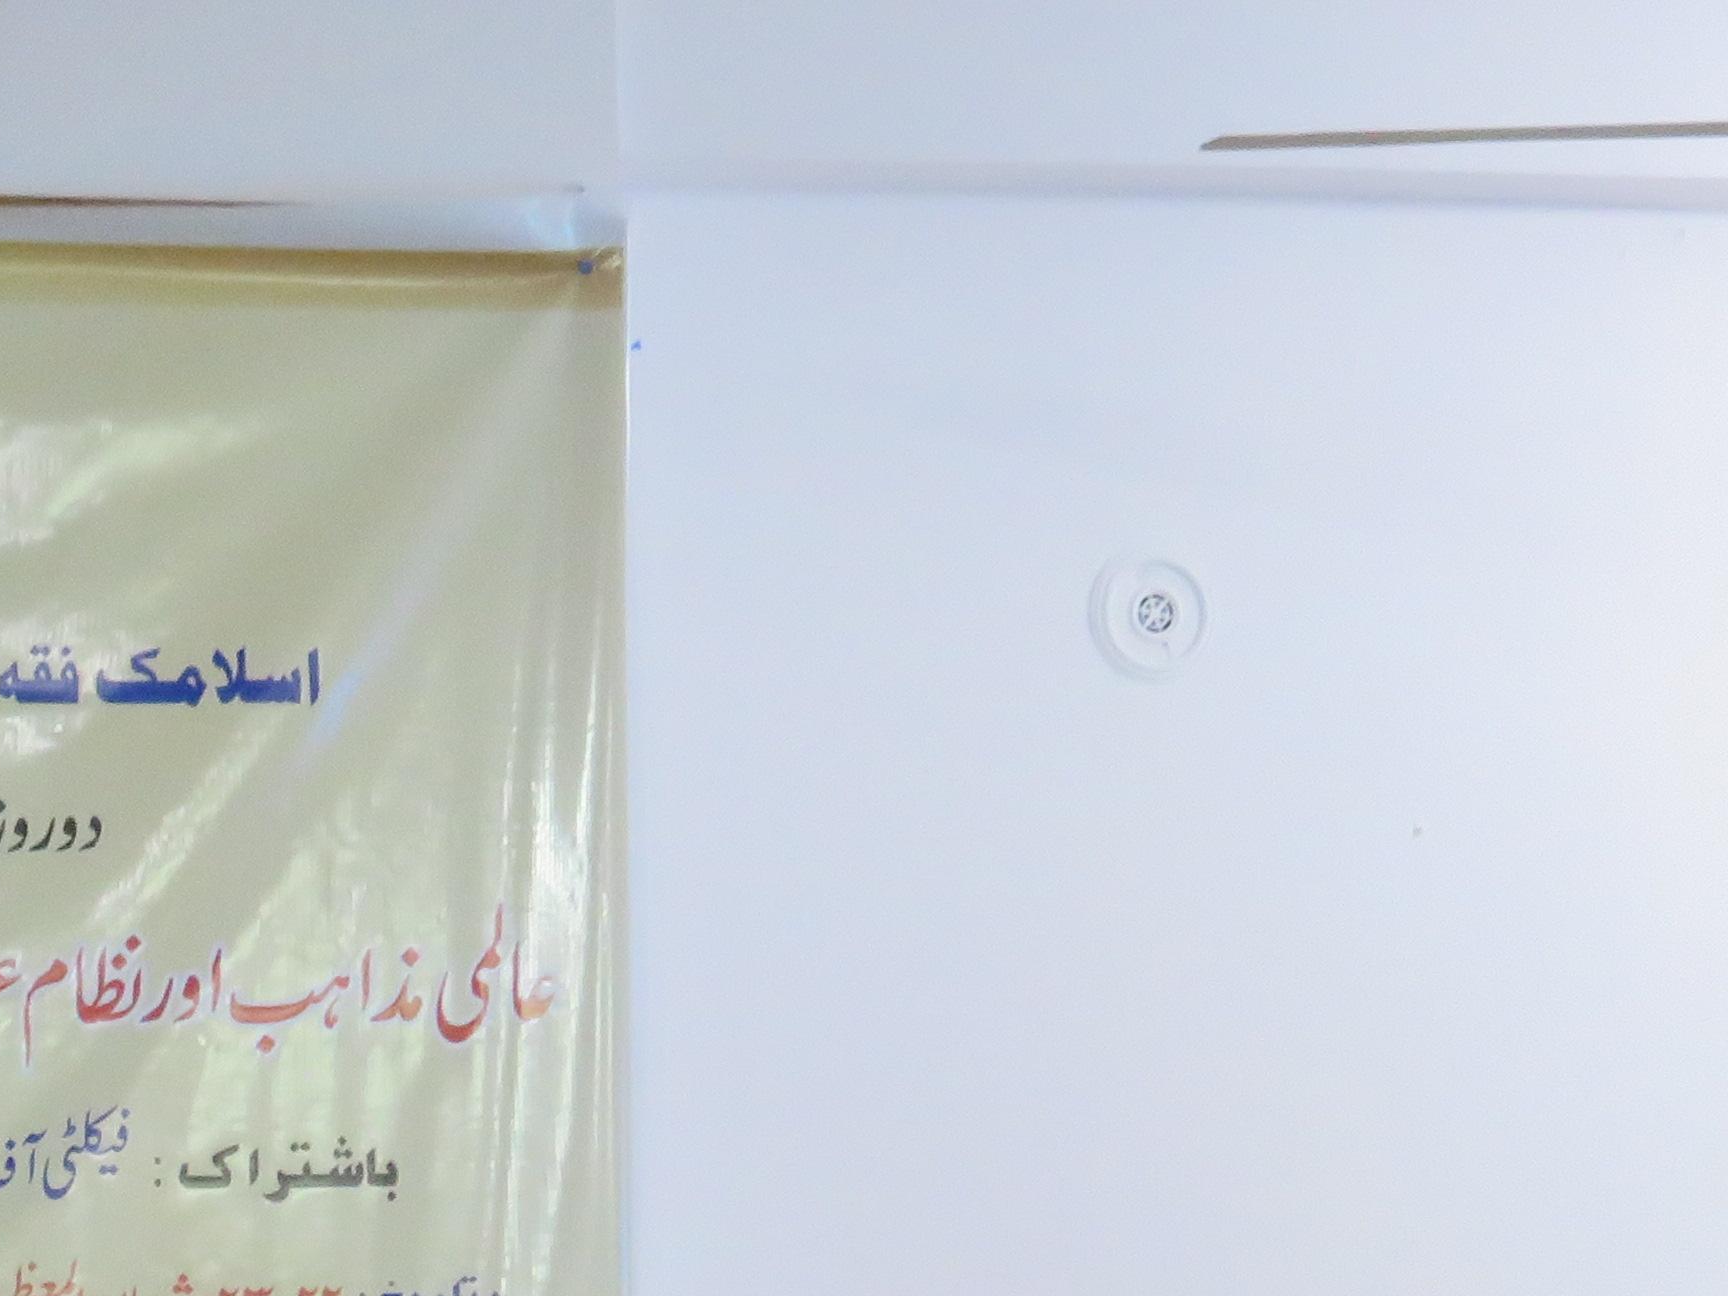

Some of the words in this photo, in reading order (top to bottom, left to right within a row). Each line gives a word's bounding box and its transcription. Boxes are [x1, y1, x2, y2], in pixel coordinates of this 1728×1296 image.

[95, 643, 321, 707] اسلامک
[24, 935, 144, 1068] نظام
[140, 947, 224, 1024] اور
[230, 946, 425, 1054] مذاہب
[435, 903, 556, 1044] عالمی
[44, 1104, 132, 1200] فیکلٹی
[178, 1136, 399, 1202] باشتراک
